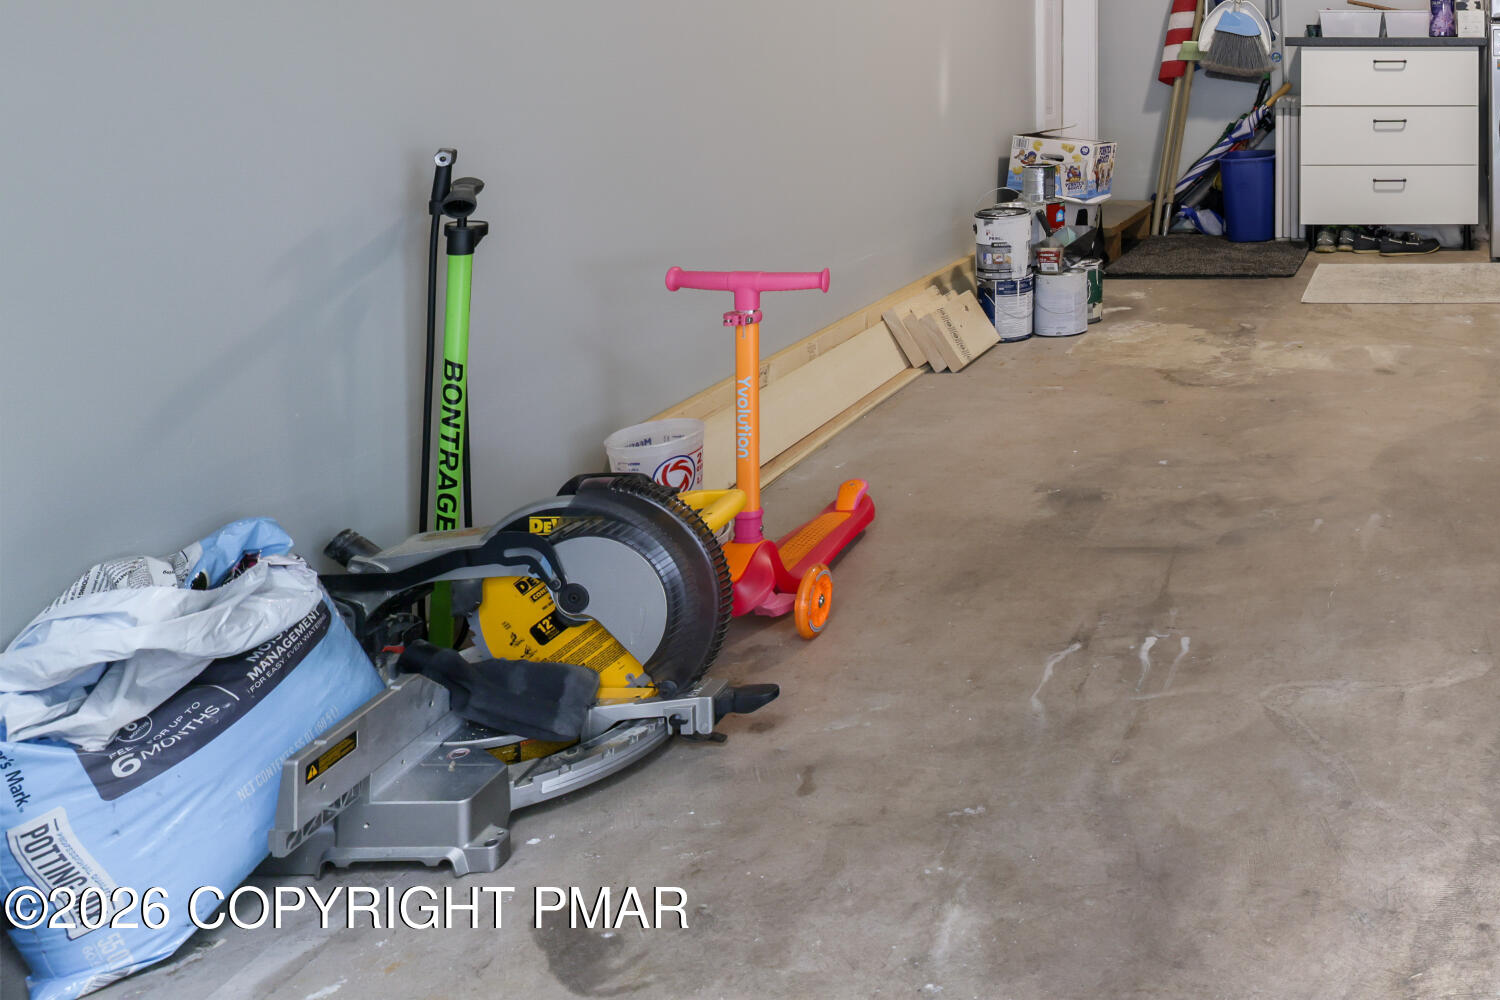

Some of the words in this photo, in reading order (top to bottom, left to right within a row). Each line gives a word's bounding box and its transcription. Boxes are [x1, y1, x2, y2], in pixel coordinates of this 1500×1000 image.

[436, 359, 463, 531] BONTRAGE
[737, 376, 752, 458] Yvolution
[246, 607, 321, 681] MANAGEMENT
[172, 713, 184, 728] UP
[184, 701, 201, 715] TO
[249, 680, 263, 693] FOR
[111, 752, 142, 778] 6
[140, 704, 220, 762] MONTHS
[20, 823, 87, 896] POTTING
